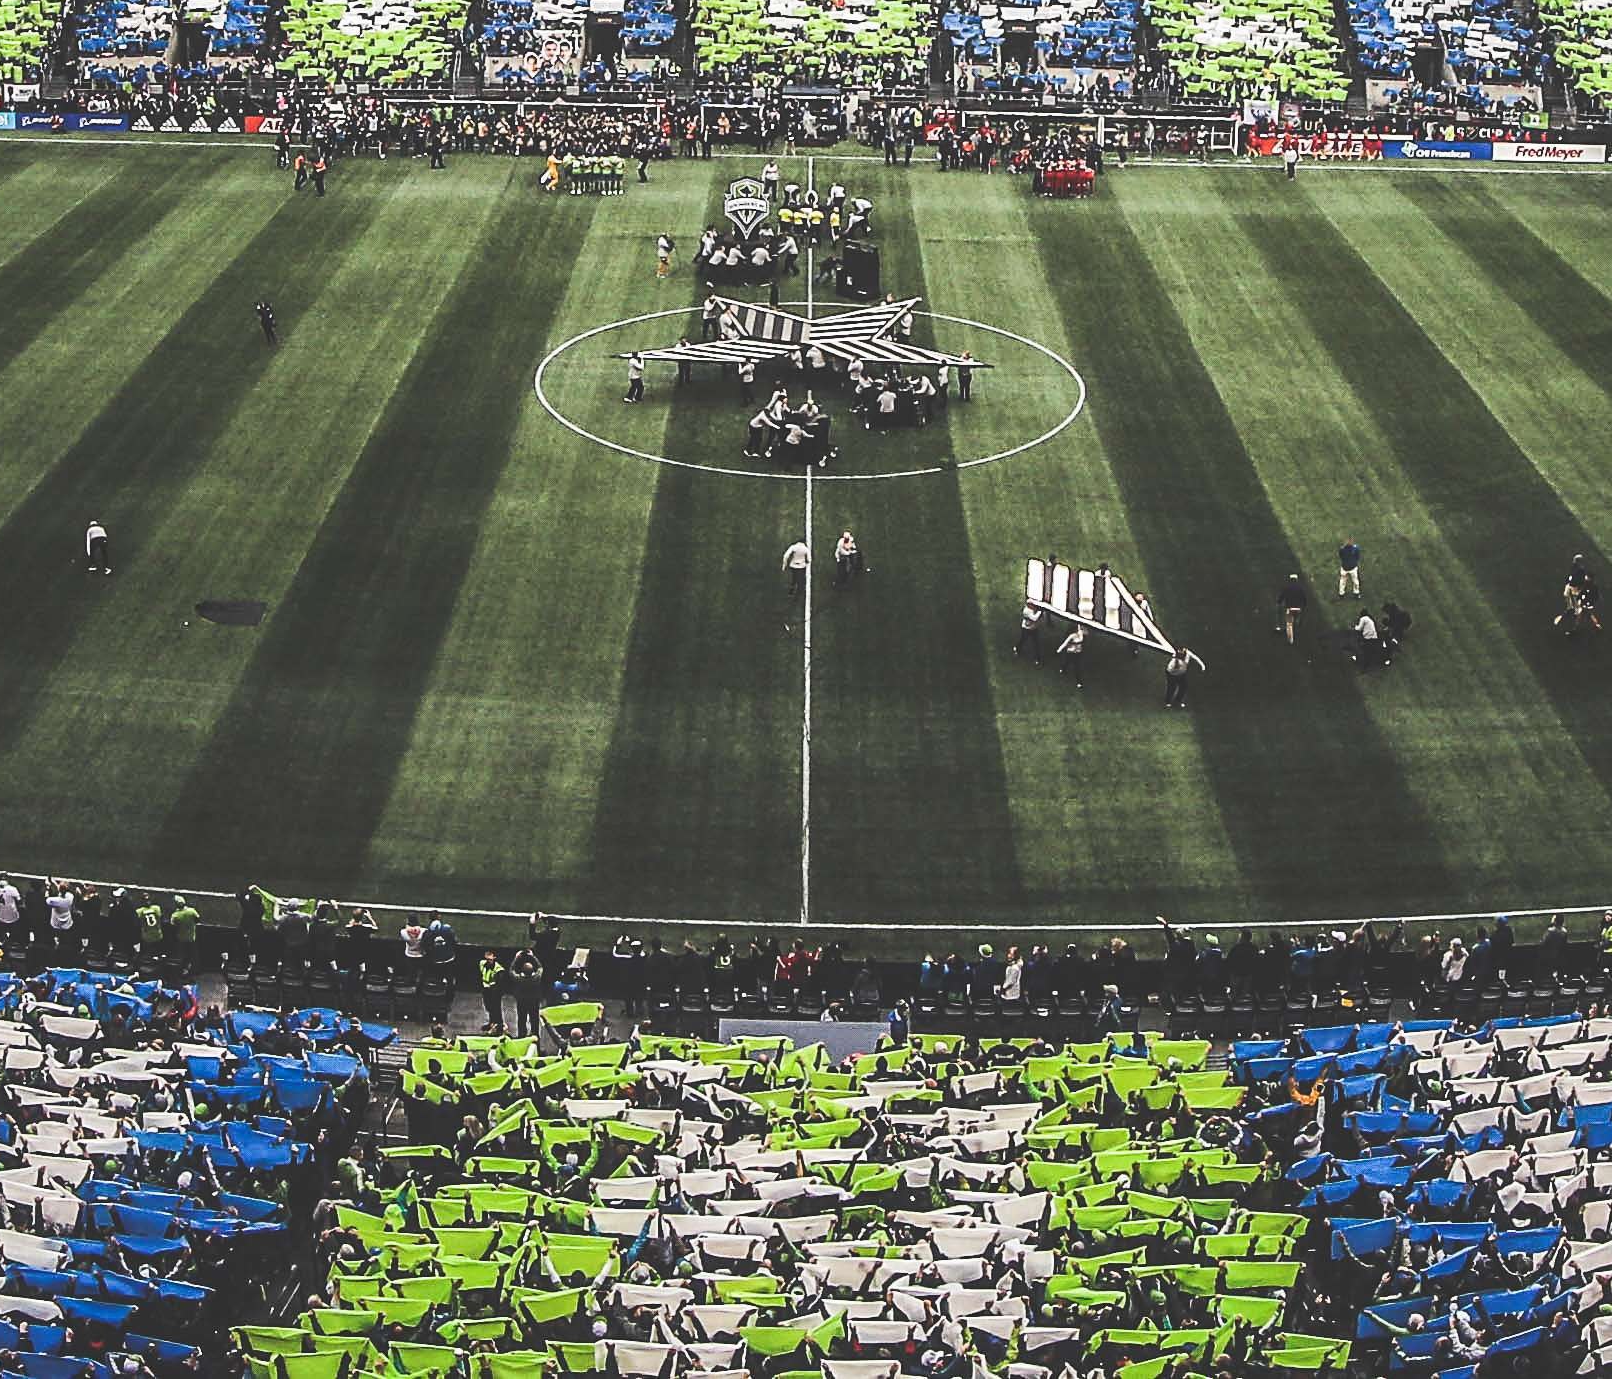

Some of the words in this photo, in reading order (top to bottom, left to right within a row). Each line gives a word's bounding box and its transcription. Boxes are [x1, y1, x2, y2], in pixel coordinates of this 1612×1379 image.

[1477, 125, 1504, 140] CUP
[1516, 145, 1542, 159] Fred
[1543, 147, 1584, 160] Meyer
